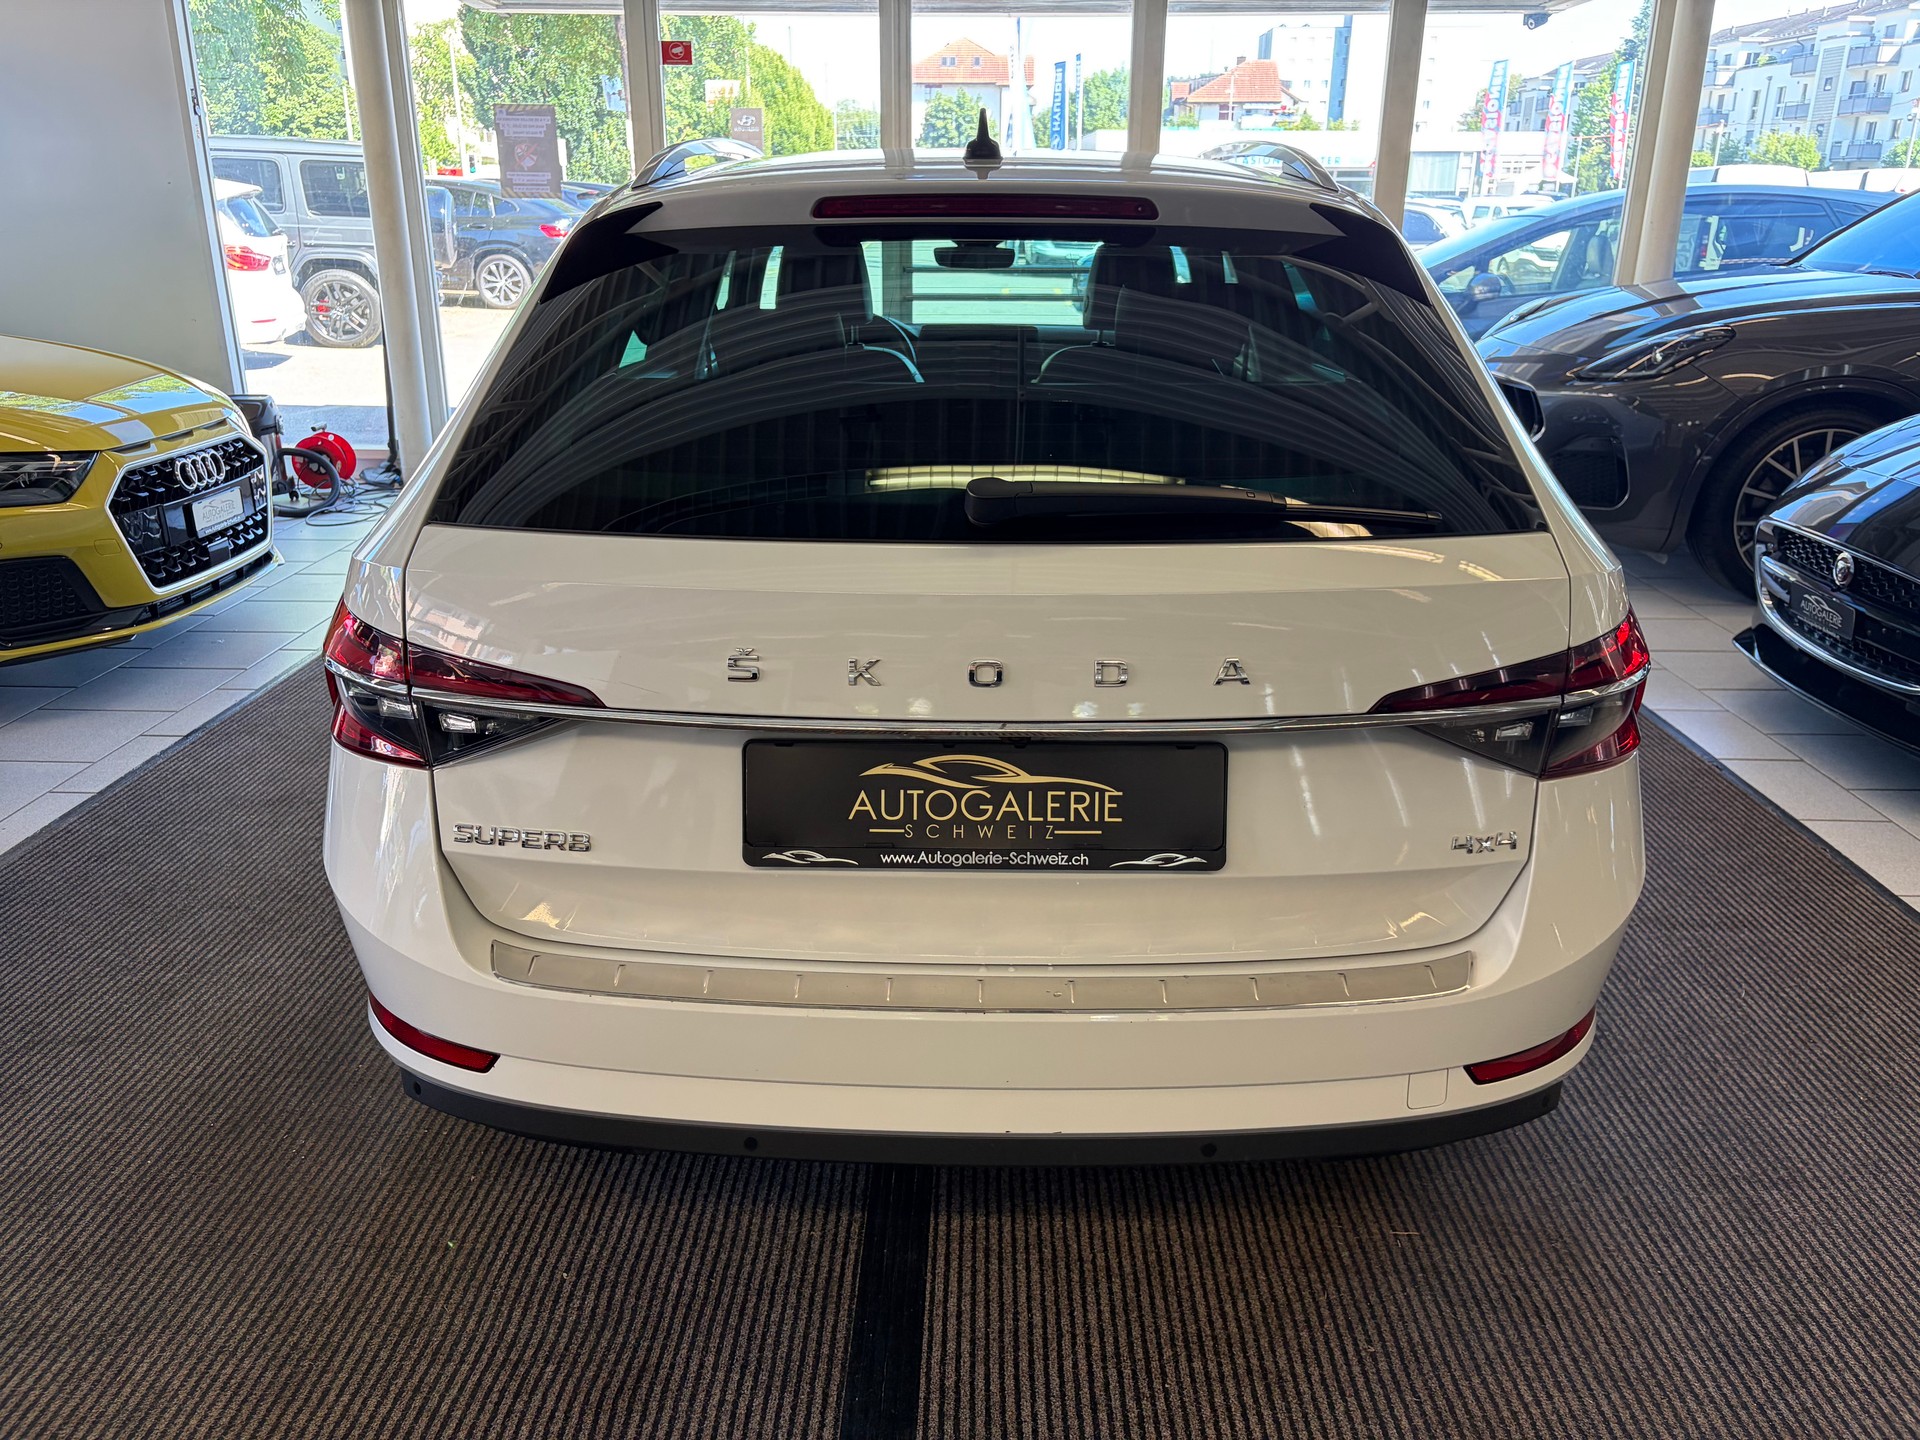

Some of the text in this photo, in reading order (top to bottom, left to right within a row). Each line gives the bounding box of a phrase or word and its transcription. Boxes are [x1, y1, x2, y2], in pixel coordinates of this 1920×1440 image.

[727, 647, 1251, 688] ŠKODA
[848, 789, 1123, 822] AUTOGALERIE
[452, 823, 592, 853] SUPERB
[904, 824, 1055, 840] SCHWEIZ
[880, 850, 1089, 868] www.Autogalerie-Schweiz.ch
